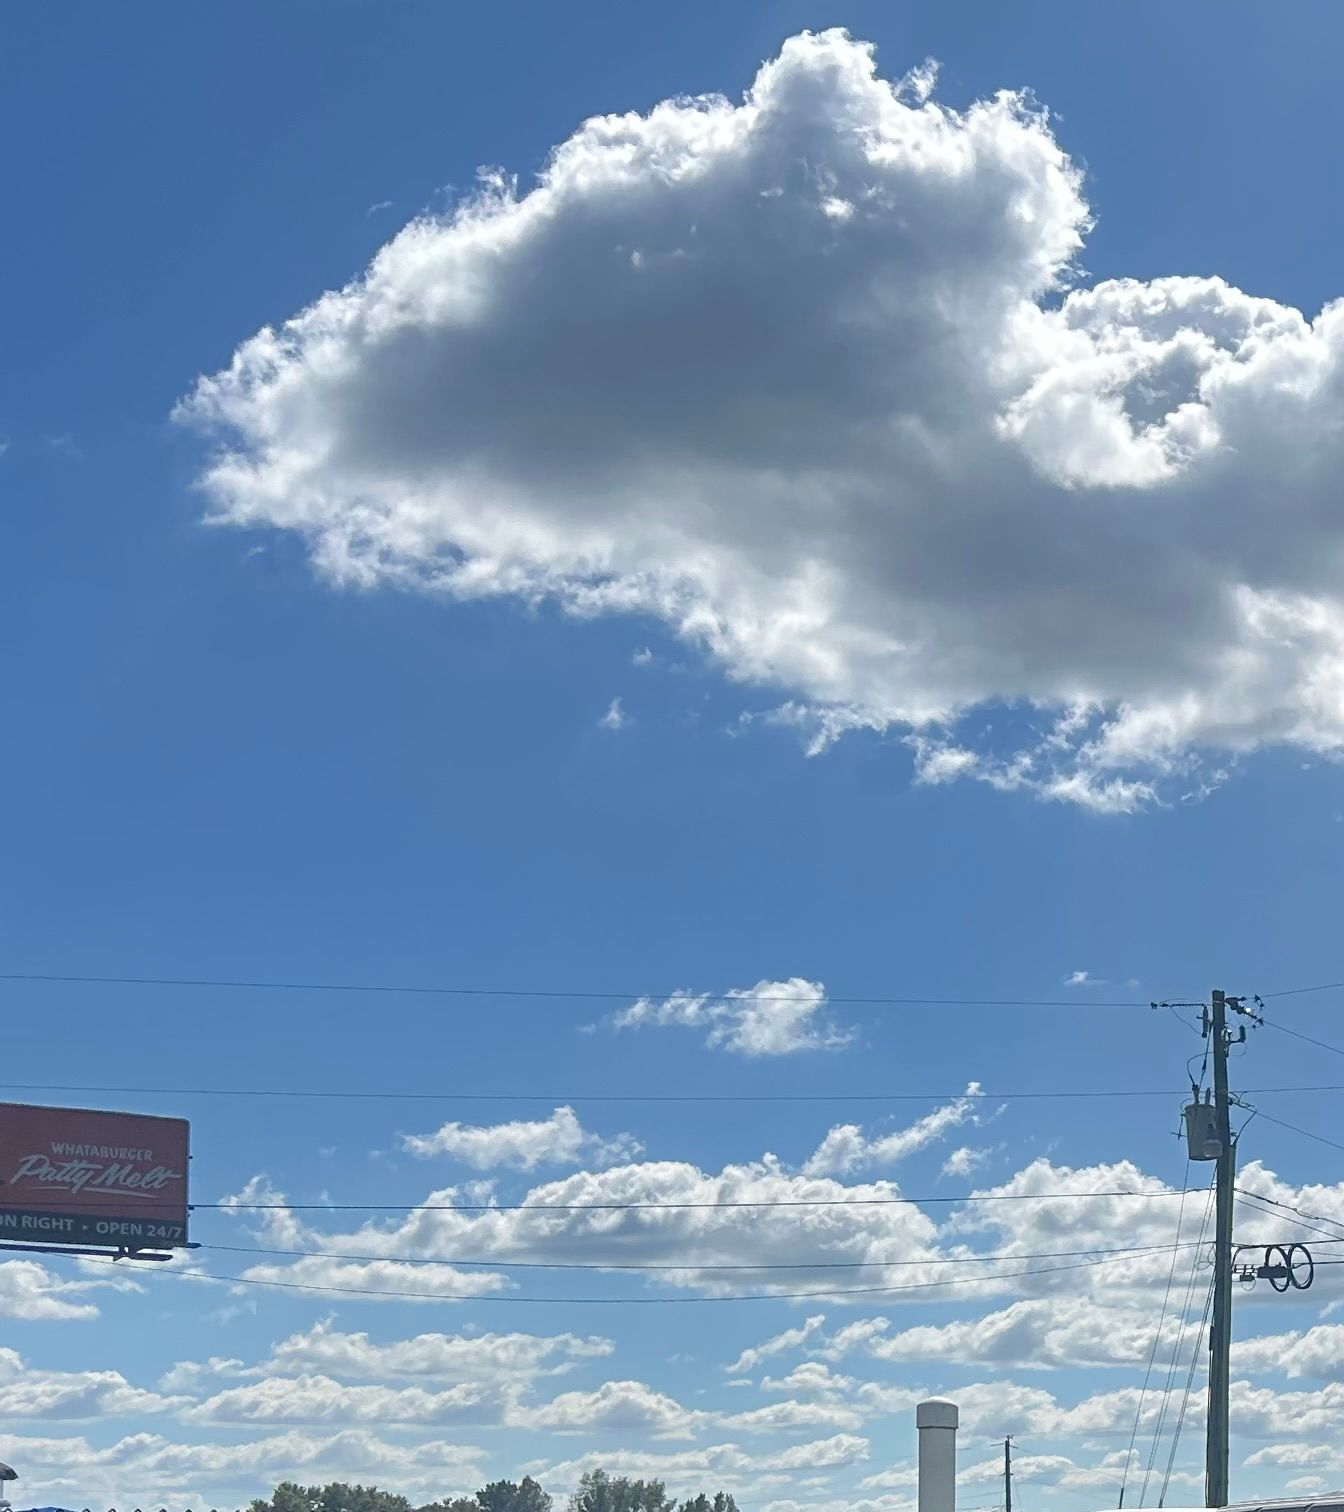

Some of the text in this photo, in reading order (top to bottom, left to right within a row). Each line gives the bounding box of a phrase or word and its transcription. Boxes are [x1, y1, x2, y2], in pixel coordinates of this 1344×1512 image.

[51, 1142, 153, 1161] WHATABURGER
[10, 1154, 182, 1194] Patty Melt
[22, 1216, 75, 1231] RIGHT
[96, 1221, 143, 1236] OPEN
[147, 1225, 183, 1239] 24/7
